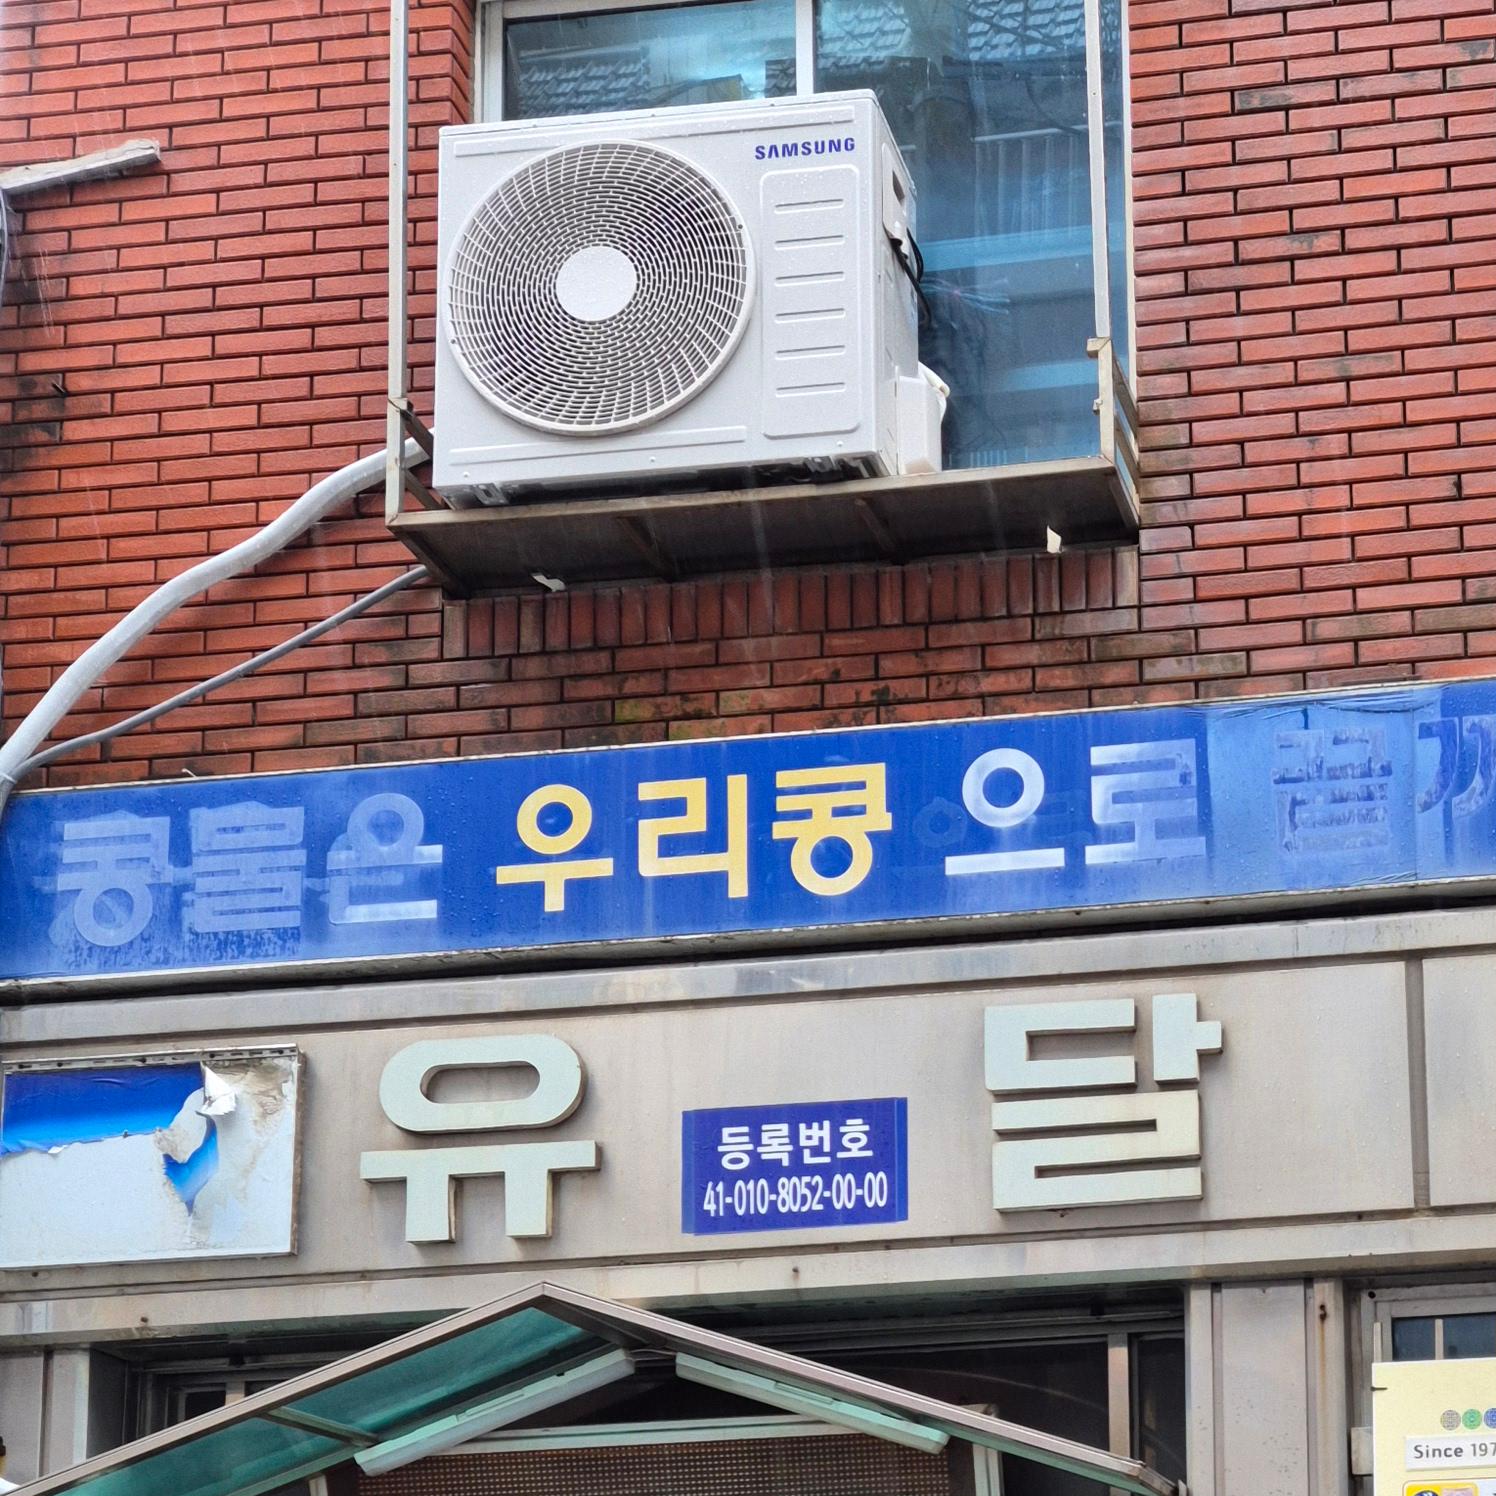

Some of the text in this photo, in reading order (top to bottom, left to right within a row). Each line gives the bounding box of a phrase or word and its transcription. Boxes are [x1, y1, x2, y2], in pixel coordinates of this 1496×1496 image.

[755, 138, 855, 160] SAMSUNG
[57, 793, 443, 946] 콩물은
[717, 1118, 874, 1170] 등록번호
[703, 1171, 888, 1217] 41-010-8052-00-00
[1414, 1444, 1464, 1459] Since
